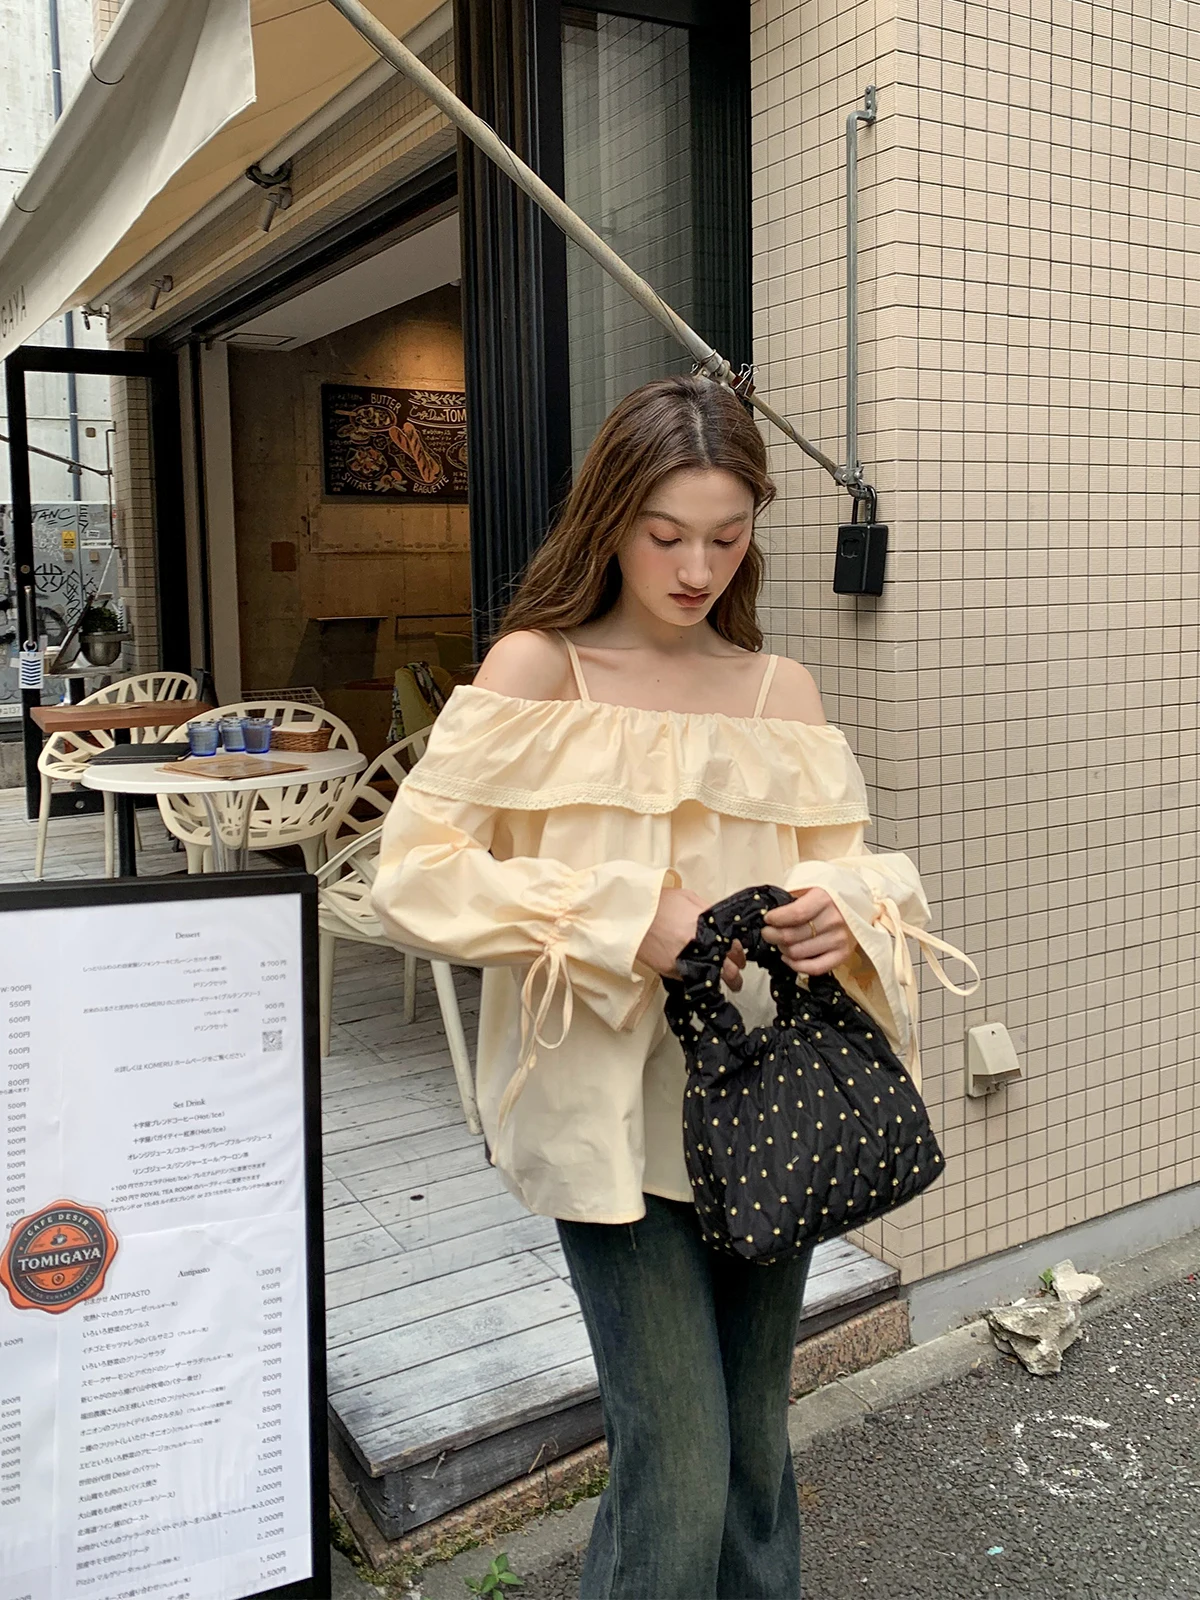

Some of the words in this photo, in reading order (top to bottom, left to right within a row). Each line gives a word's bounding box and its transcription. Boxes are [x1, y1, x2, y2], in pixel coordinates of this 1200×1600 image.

[371, 393, 402, 414] BUTTER
[413, 475, 450, 494] BAGUETTE
[175, 931, 200, 940] Dessert
[193, 980, 228, 988] ドリンクセット
[9, 1000, 31, 1008] 550円
[8, 1015, 31, 1024] 600円
[193, 1023, 228, 1032] ドリンクセット
[8, 1031, 31, 1040] 600円
[8, 1046, 30, 1055] 600円
[8, 1062, 30, 1071] 700円
[143, 1060, 174, 1070] KOMERU
[8, 1078, 30, 1087] 800円
[7, 1101, 26, 1110] 500円
[172, 1101, 184, 1110] Set
[185, 1098, 206, 1108] Drink
[7, 1113, 26, 1122] 500円
[7, 1125, 26, 1134] 500円
[7, 1137, 26, 1146] 500円
[7, 1149, 26, 1158] 500円
[7, 1161, 26, 1170] 500円
[6, 1173, 26, 1182] 600円
[6, 1185, 26, 1194] 600円
[140, 1190, 160, 1199] ROYAL
[162, 1188, 173, 1196] TEA
[174, 1185, 193, 1194] ROOM
[6, 1197, 25, 1206] 600円
[27, 1216, 53, 1237] CAFE
[58, 1213, 89, 1227] DESIR
[18, 1247, 101, 1271] TOMIGAYA
[177, 1267, 210, 1278] Antipasto
[260, 1281, 281, 1291] 650円
[109, 1289, 151, 1302] ANTIPASTO
[262, 1296, 282, 1306] 600円
[262, 1311, 282, 1321] 700円
[262, 1326, 282, 1336] 950円
[262, 1356, 282, 1367] 700円
[261, 1372, 282, 1383] 800円
[261, 1387, 282, 1398] 750円
[261, 1403, 282, 1414] 850円
